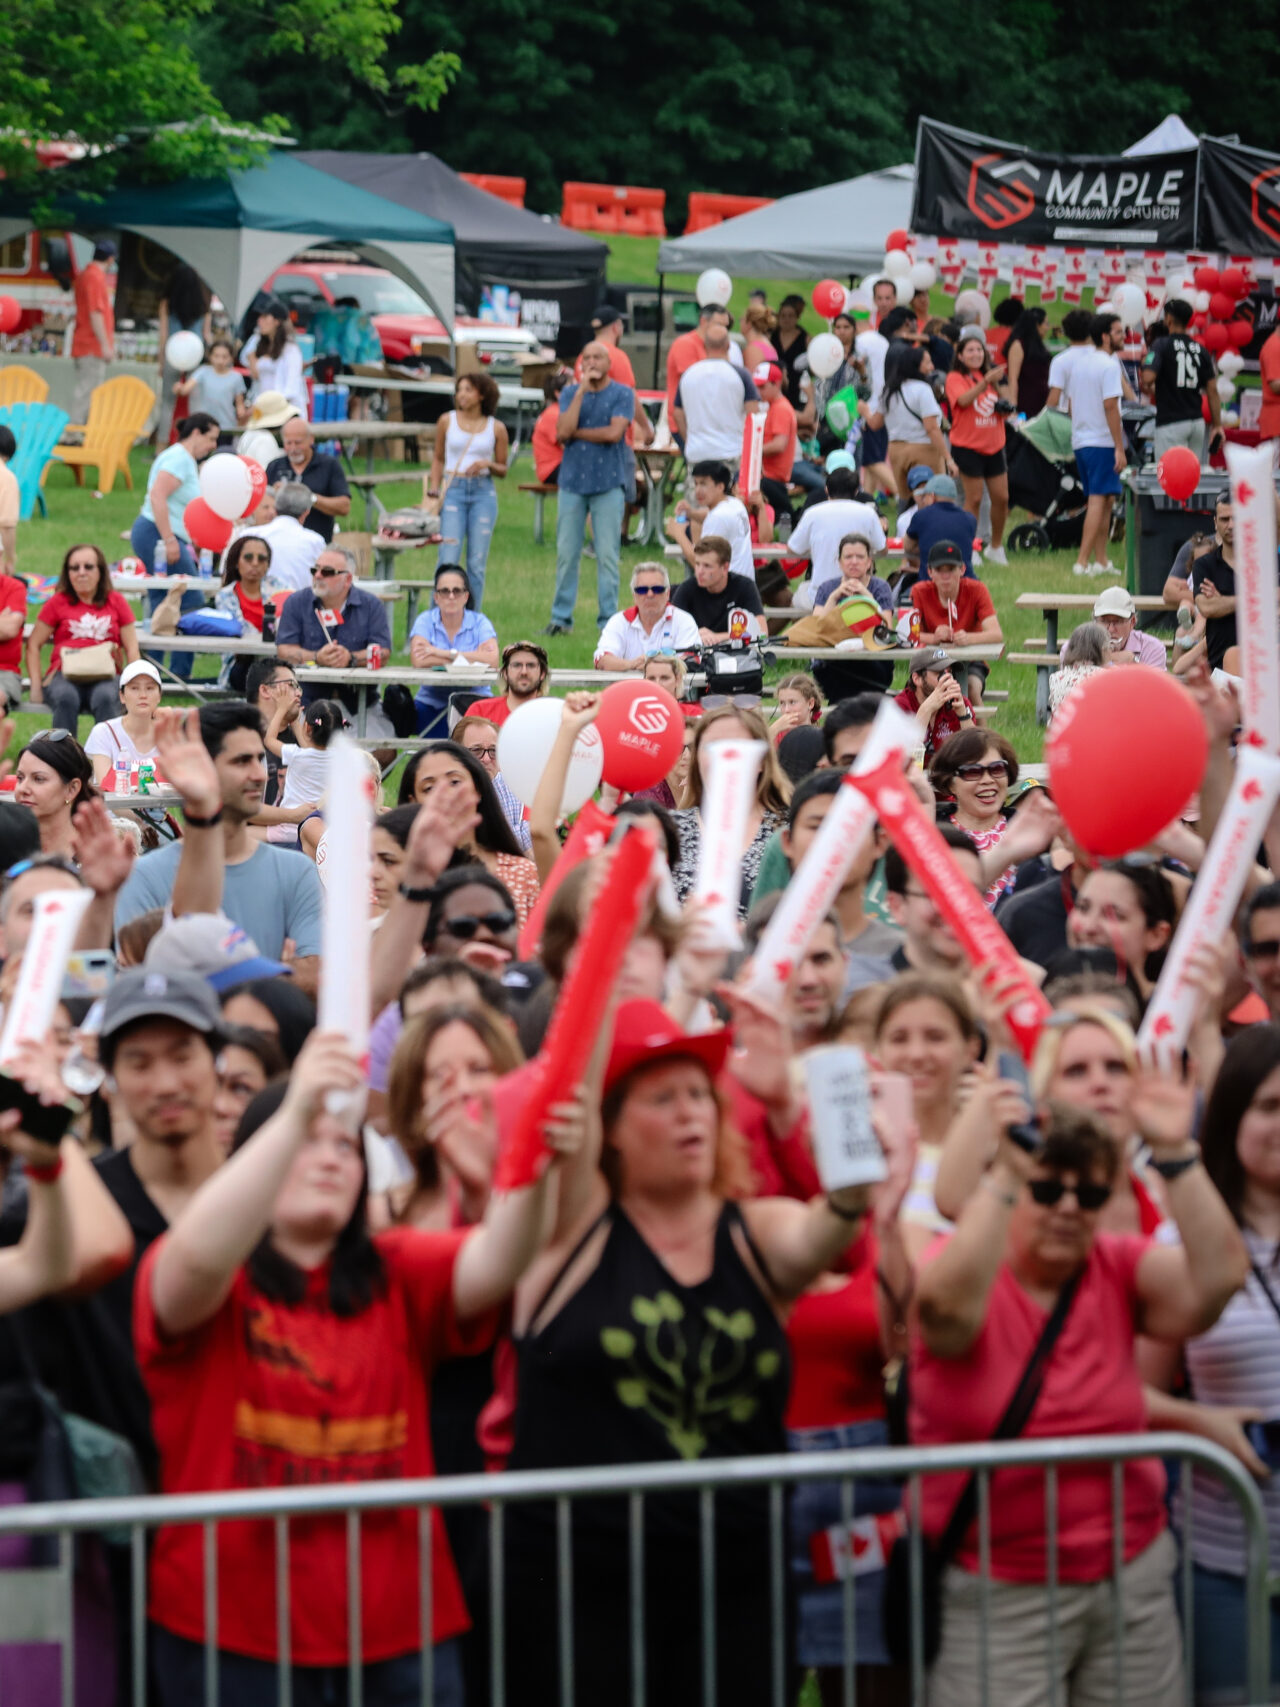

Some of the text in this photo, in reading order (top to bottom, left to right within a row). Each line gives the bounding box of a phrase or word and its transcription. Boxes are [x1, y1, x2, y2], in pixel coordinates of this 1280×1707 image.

[1045, 170, 1184, 206] MAPLE
[1045, 204, 1180, 220] COMMUNITY CHURCH
[618, 731, 661, 753] MAPLE
